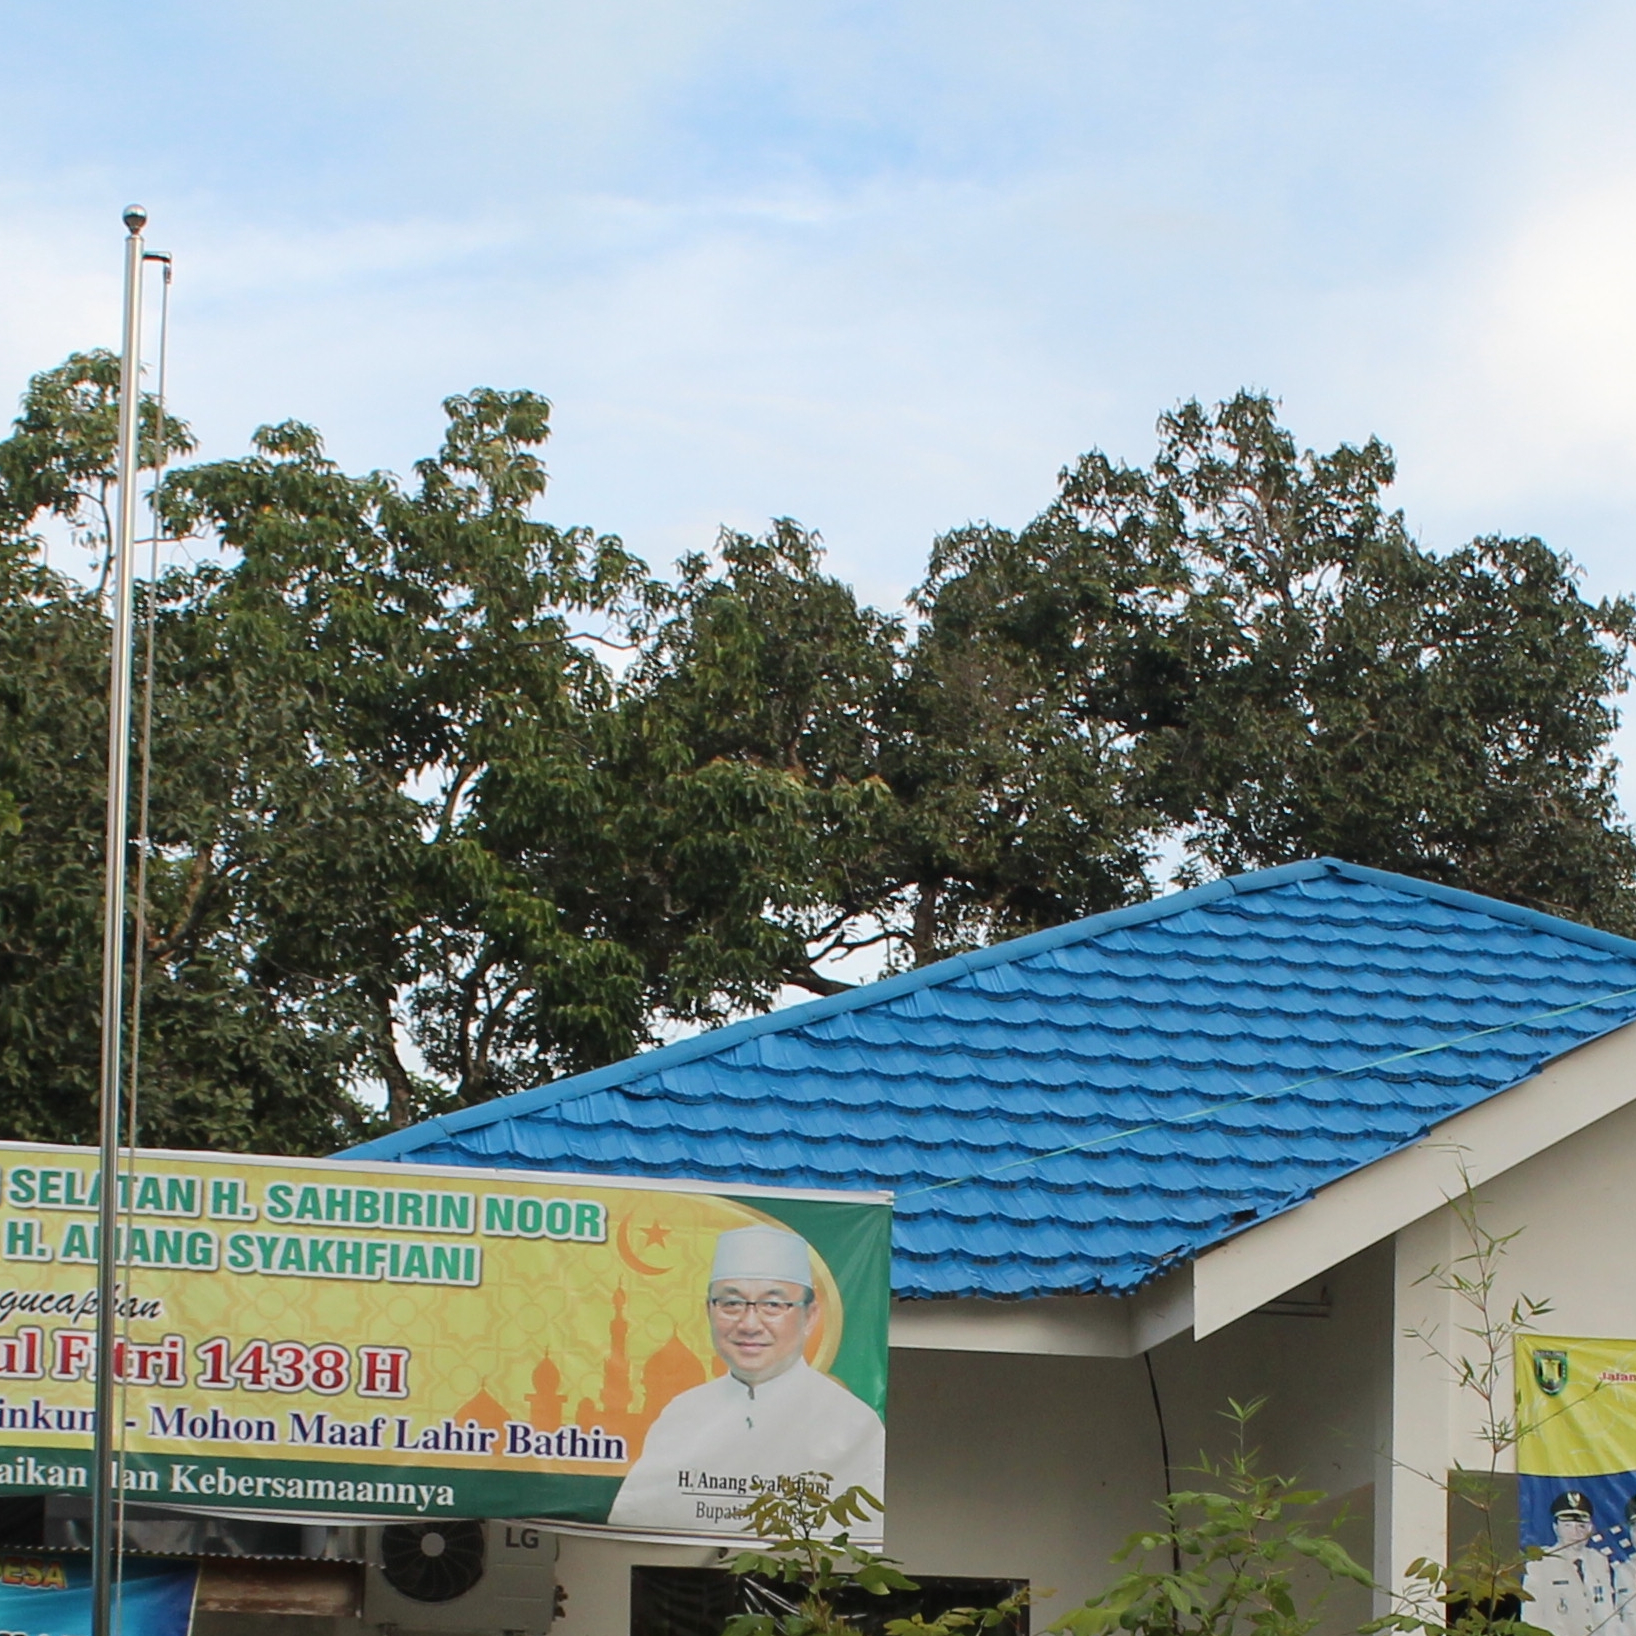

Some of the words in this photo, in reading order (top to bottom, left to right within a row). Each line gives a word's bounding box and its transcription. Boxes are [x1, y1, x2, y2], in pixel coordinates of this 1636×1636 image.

[9, 1168, 195, 1212] SELATAN
[212, 1181, 251, 1214] H.
[268, 1184, 469, 1229] SAHBIRIN
[485, 1196, 602, 1238] NOOR
[7, 1221, 46, 1256] H.
[62, 1224, 213, 1266] ANANG
[228, 1234, 476, 1281] SYAKHFIANI
[58, 1335, 180, 1382] Ftri
[201, 1341, 345, 1391] 1438
[364, 1352, 406, 1393] H
[149, 1406, 277, 1442] Mohon
[289, 1411, 384, 1447] Maaf
[395, 1417, 496, 1454] Lahir
[506, 1424, 626, 1461] Bathin
[170, 1465, 453, 1509] Kebersamaannya
[678, 1471, 694, 1488] H.
[698, 1472, 746, 1493] Anang
[505, 1526, 539, 1549] LG
